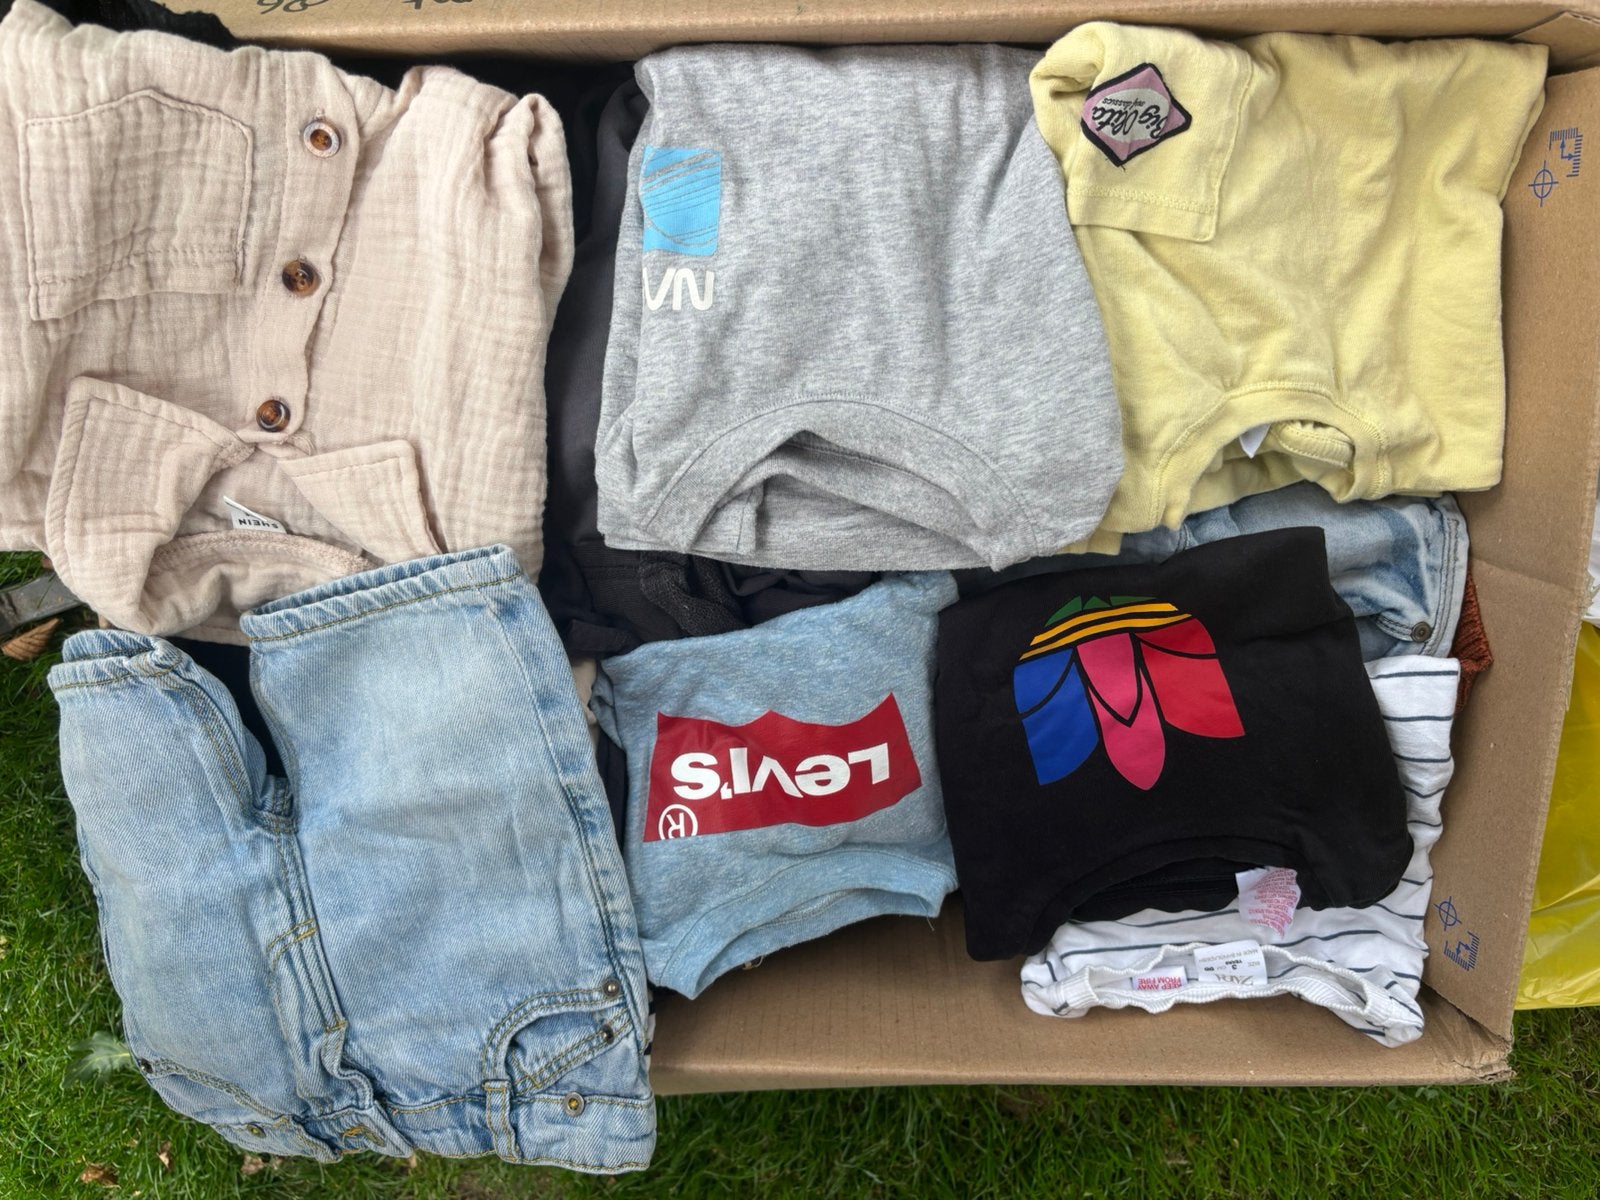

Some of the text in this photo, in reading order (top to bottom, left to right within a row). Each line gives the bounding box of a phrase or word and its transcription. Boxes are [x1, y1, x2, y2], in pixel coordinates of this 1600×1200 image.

[1092, 106, 1138, 136] Olita
[238, 518, 279, 529] SHEIN
[1158, 976, 1181, 984] FROM
[1214, 973, 1254, 986] ZARA
[1161, 982, 1182, 990] KEEP
